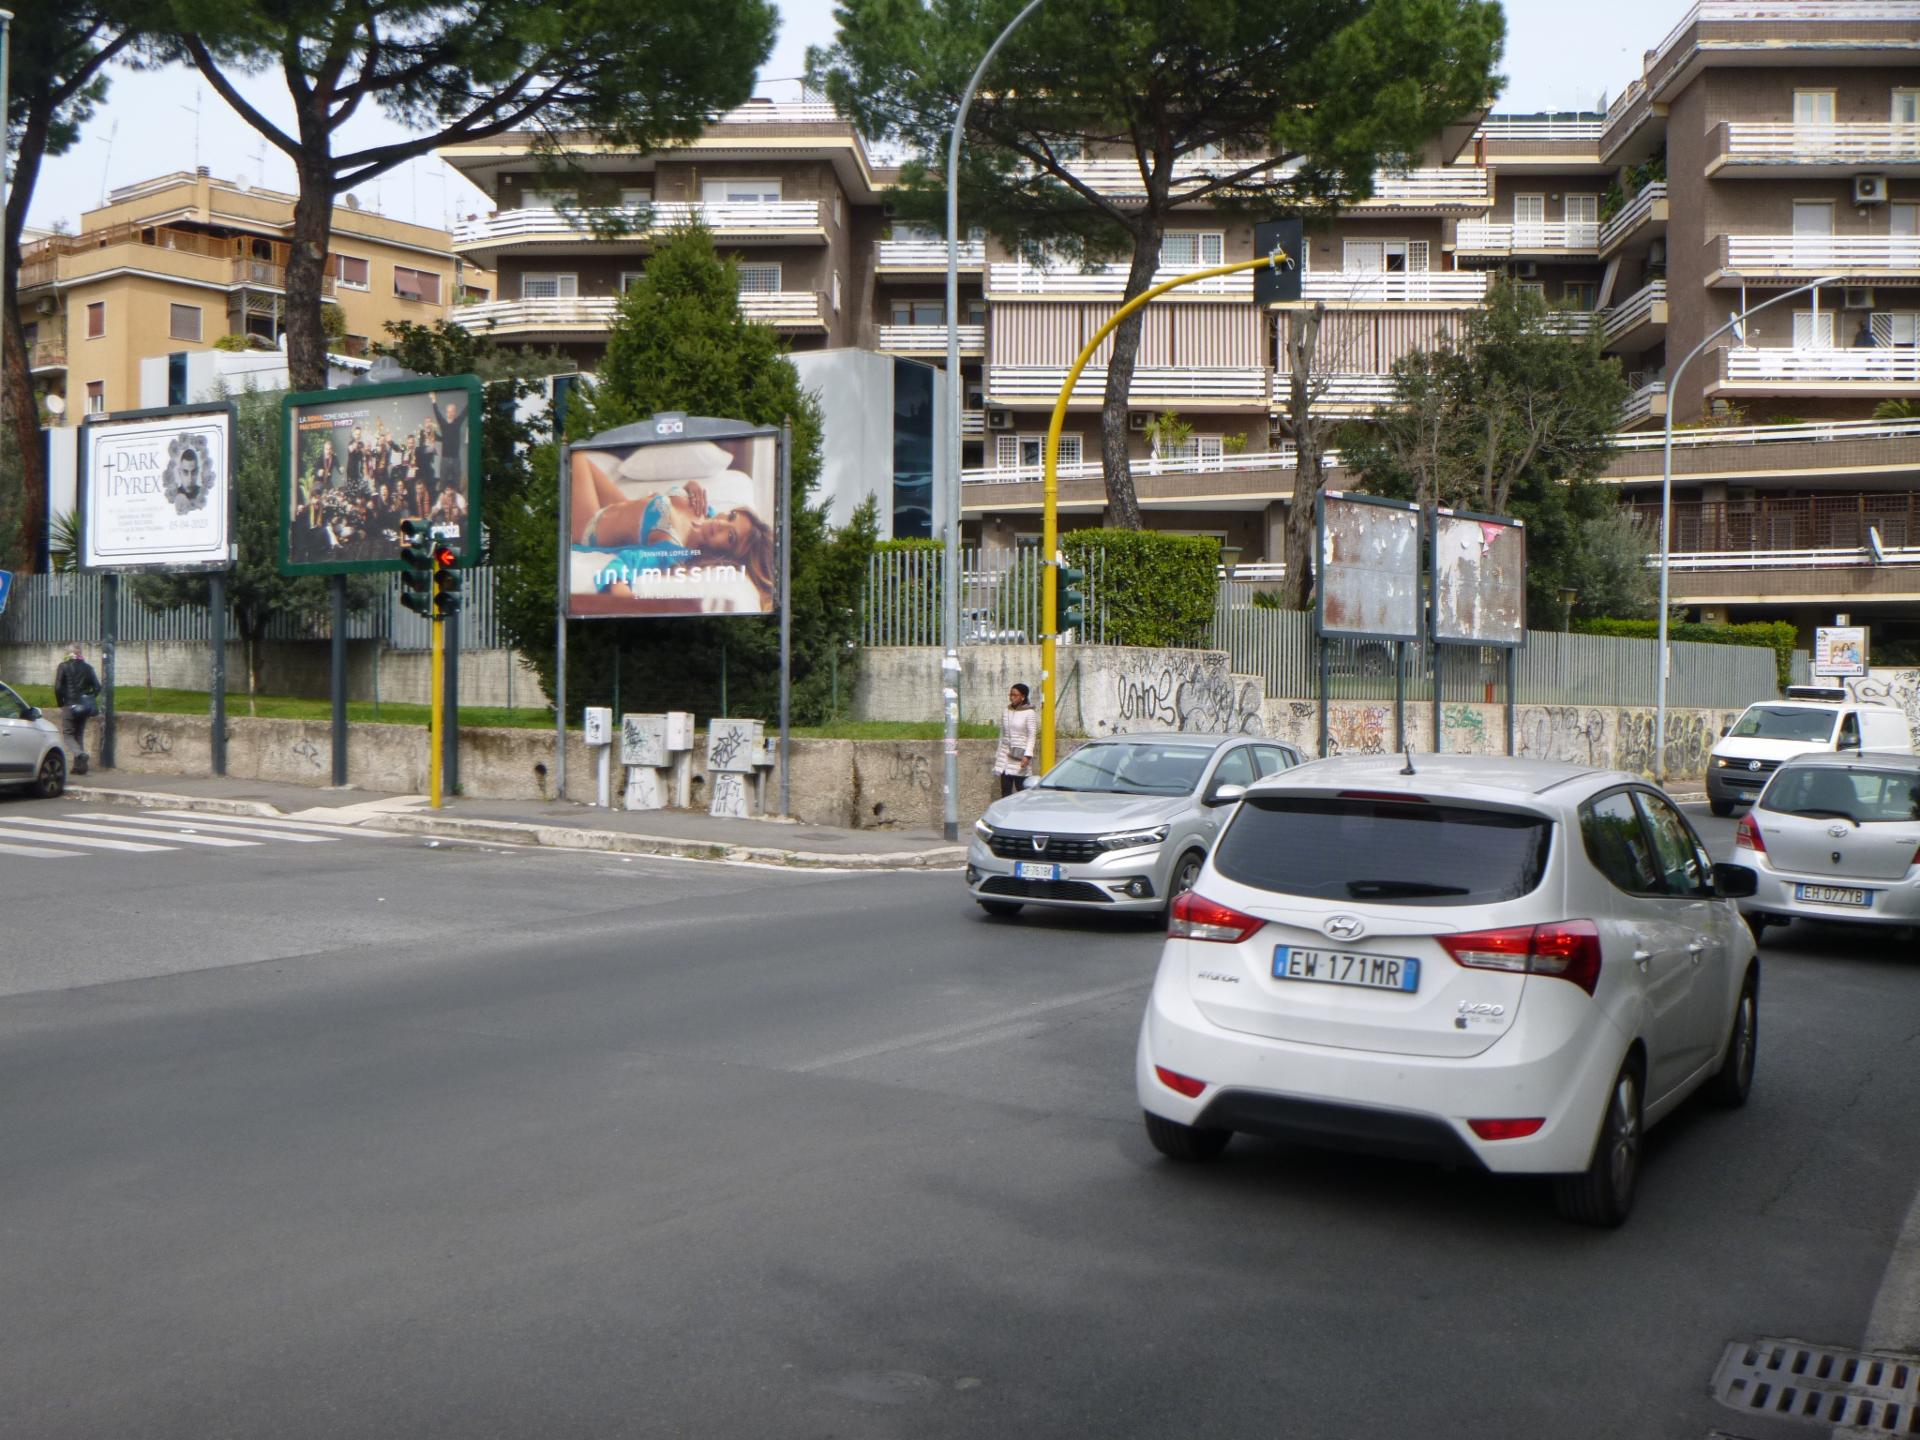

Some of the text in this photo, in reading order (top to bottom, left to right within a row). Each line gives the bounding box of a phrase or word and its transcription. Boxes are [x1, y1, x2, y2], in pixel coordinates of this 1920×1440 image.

[116, 450, 161, 473] DARK
[114, 474, 163, 496] PYREX
[669, 549, 689, 557] LOPEZ
[595, 564, 747, 585] intimissimi
[1804, 885, 1863, 903] EH 077YB
[1288, 951, 1400, 986] EW 171MR
